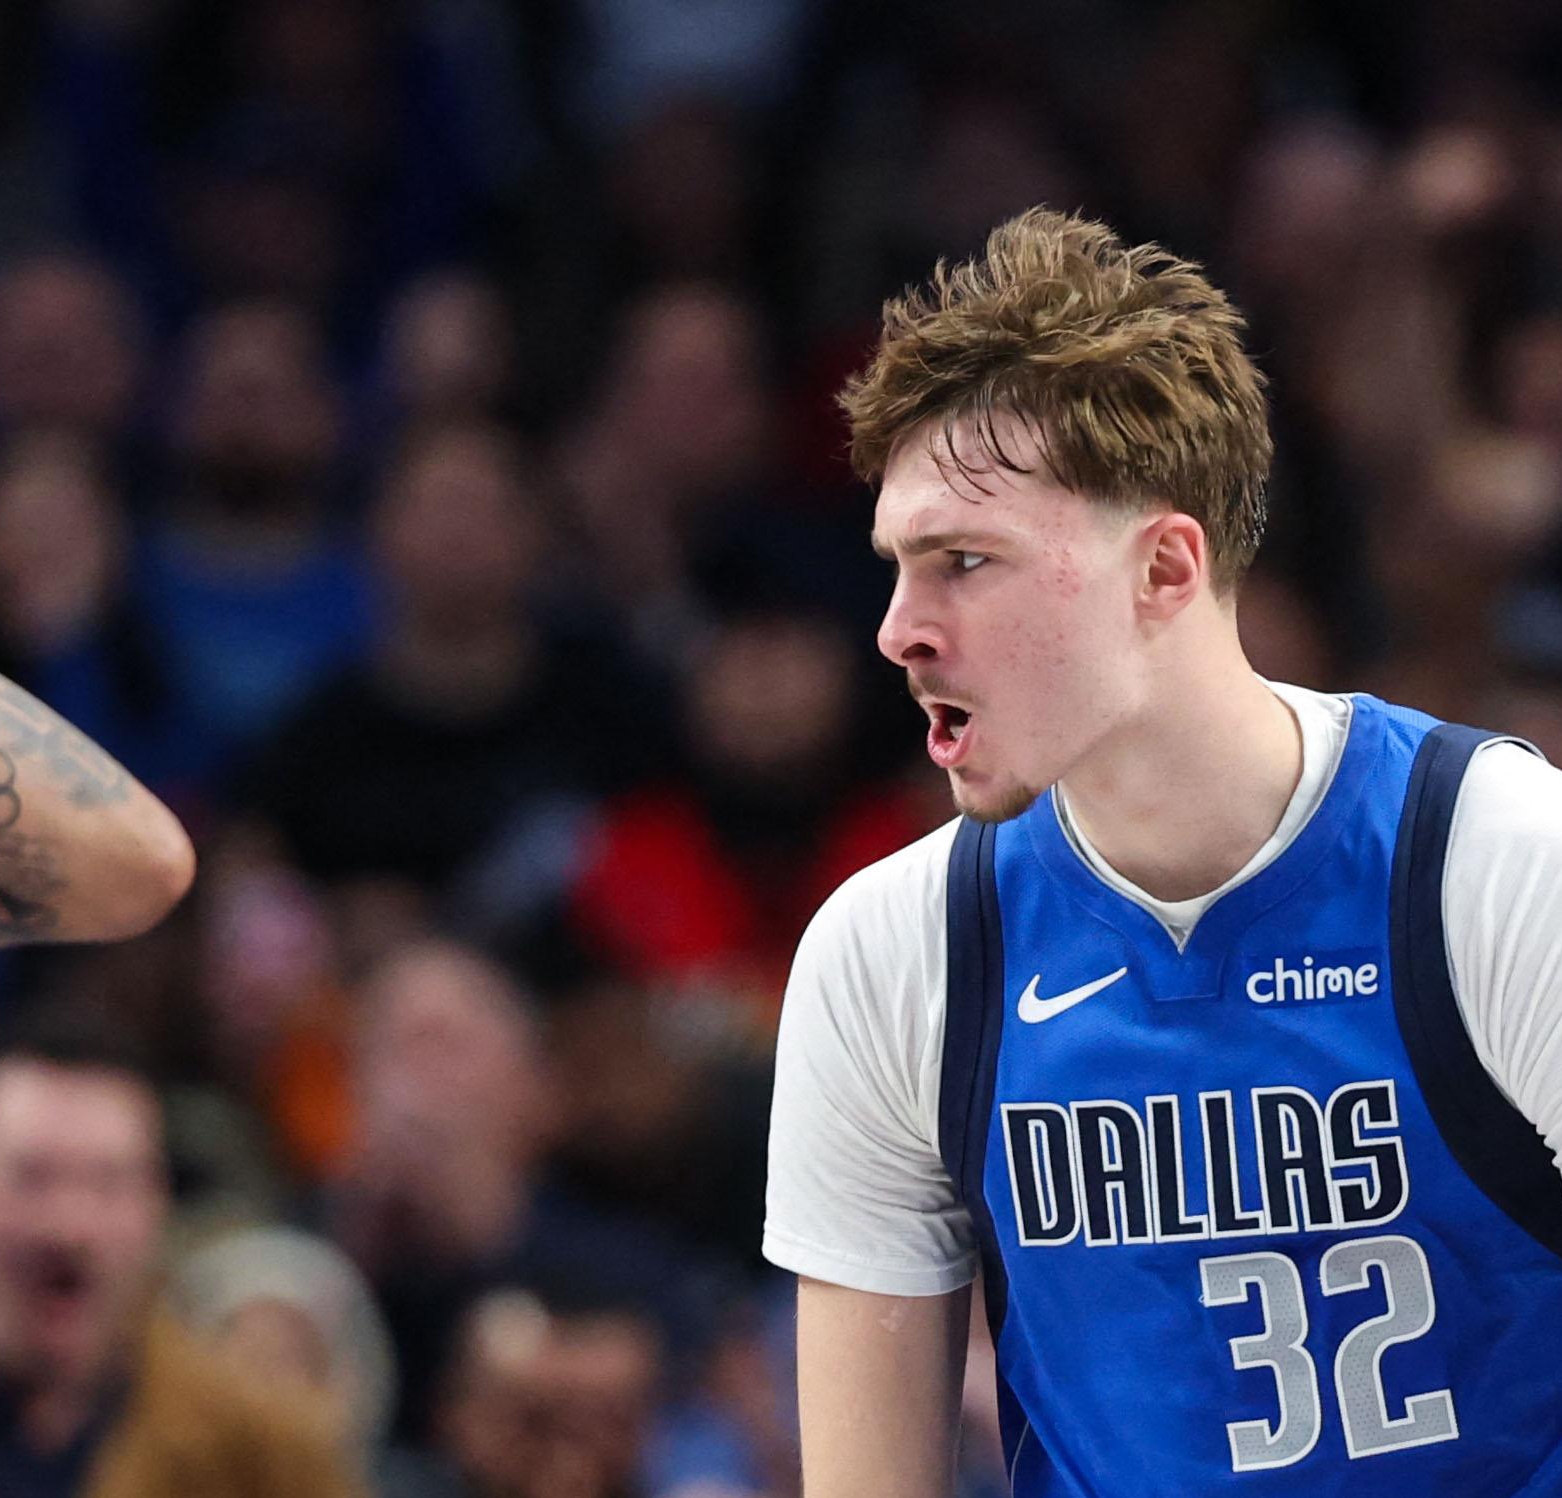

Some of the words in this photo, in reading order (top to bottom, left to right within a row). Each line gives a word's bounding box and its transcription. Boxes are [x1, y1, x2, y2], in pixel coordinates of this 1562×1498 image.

[1246, 956, 1378, 1003] chime
[1001, 1079, 1409, 1247] DALLAS
[1199, 1235, 1459, 1472] 32
